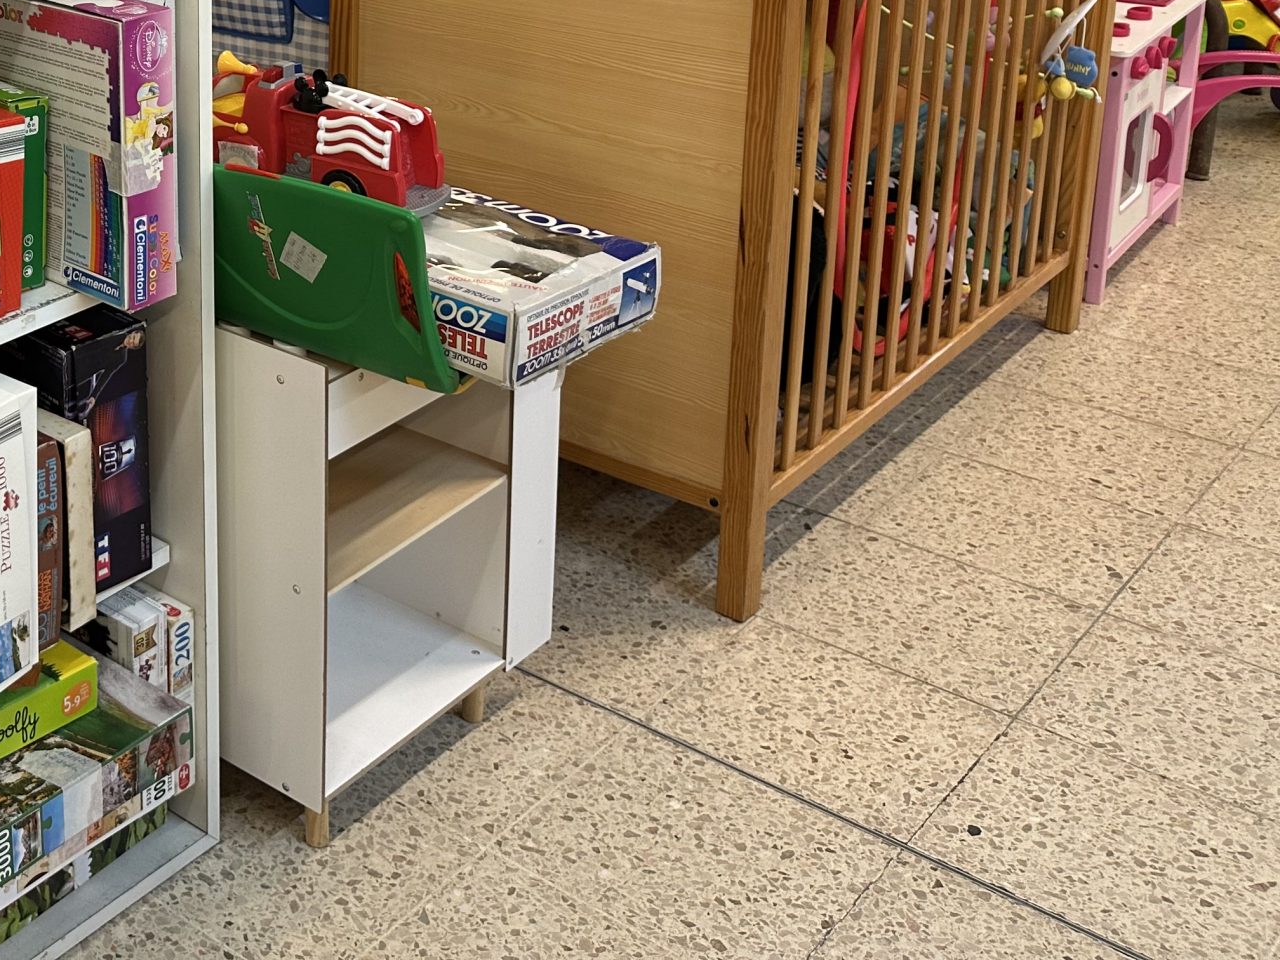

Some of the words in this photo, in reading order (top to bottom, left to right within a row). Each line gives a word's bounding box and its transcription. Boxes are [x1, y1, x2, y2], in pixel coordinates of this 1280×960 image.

[72, 269, 119, 298] Clementoni
[136, 233, 146, 300] Clementoni
[527, 301, 584, 340] TELESCOPE
[527, 319, 580, 359] TERRESTRE
[437, 324, 488, 359] TELES
[39, 469, 47, 501] petit
[47, 457, 57, 510] écureuil
[1, 514, 12, 575] PUZZLE
[98, 534, 110, 578] TF1
[44, 569, 52, 610] NATHAN
[175, 622, 190, 666] 200
